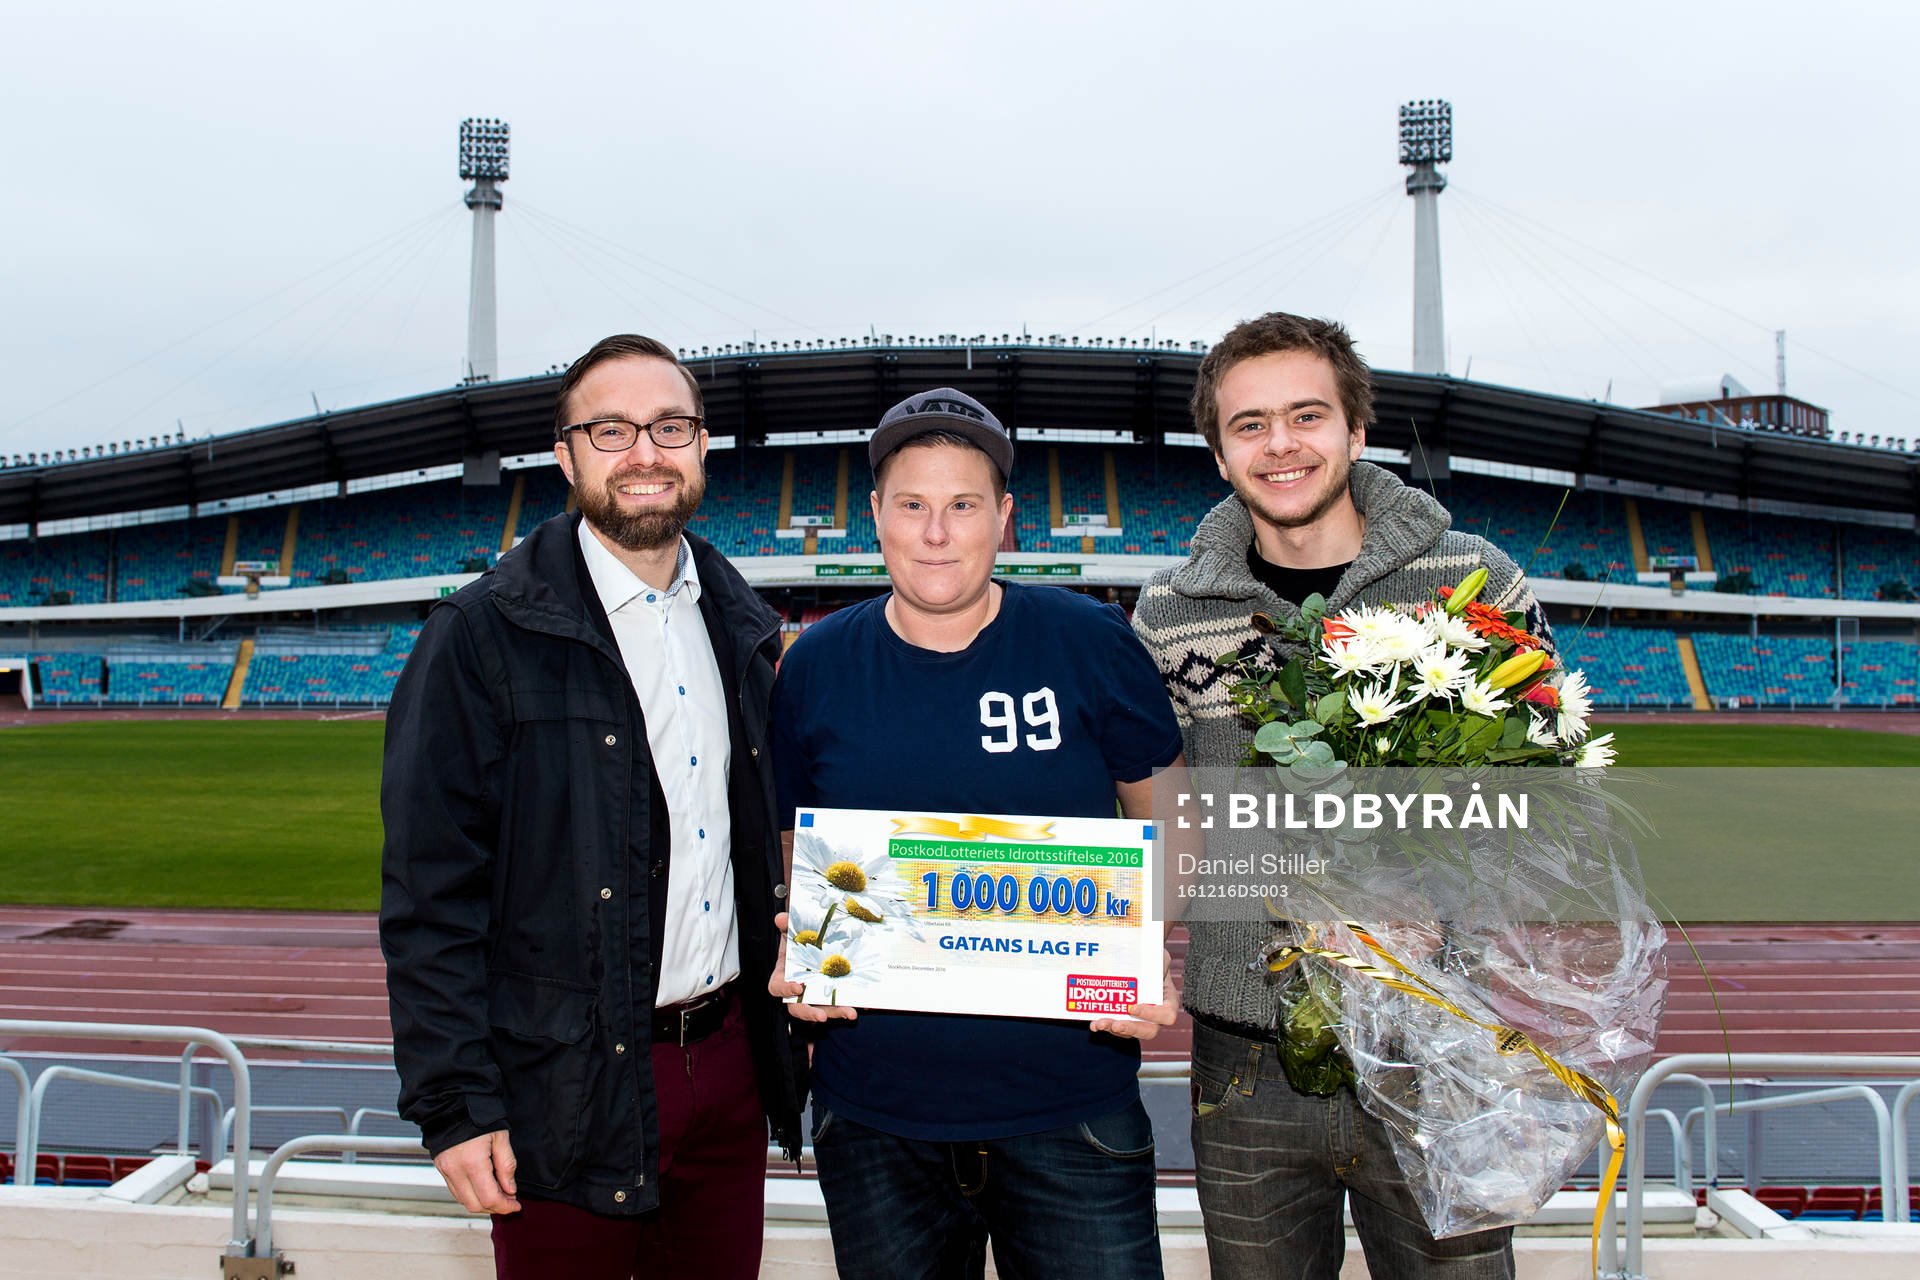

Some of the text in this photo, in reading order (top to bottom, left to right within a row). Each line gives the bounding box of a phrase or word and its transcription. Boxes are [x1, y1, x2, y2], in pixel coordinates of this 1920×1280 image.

[980, 686, 1062, 753] 99
[891, 843, 1139, 865] PostkodLotteriets Idrottsstiftelse 2016
[922, 872, 1131, 917] 1 000 000 kr
[939, 935, 1100, 957] GATANS LAG FF
[1076, 978, 1129, 988] POSTKODLOTTERIETS
[1068, 987, 1136, 1003] IDROTTS
[1076, 1001, 1128, 1013] STIFTELSE
